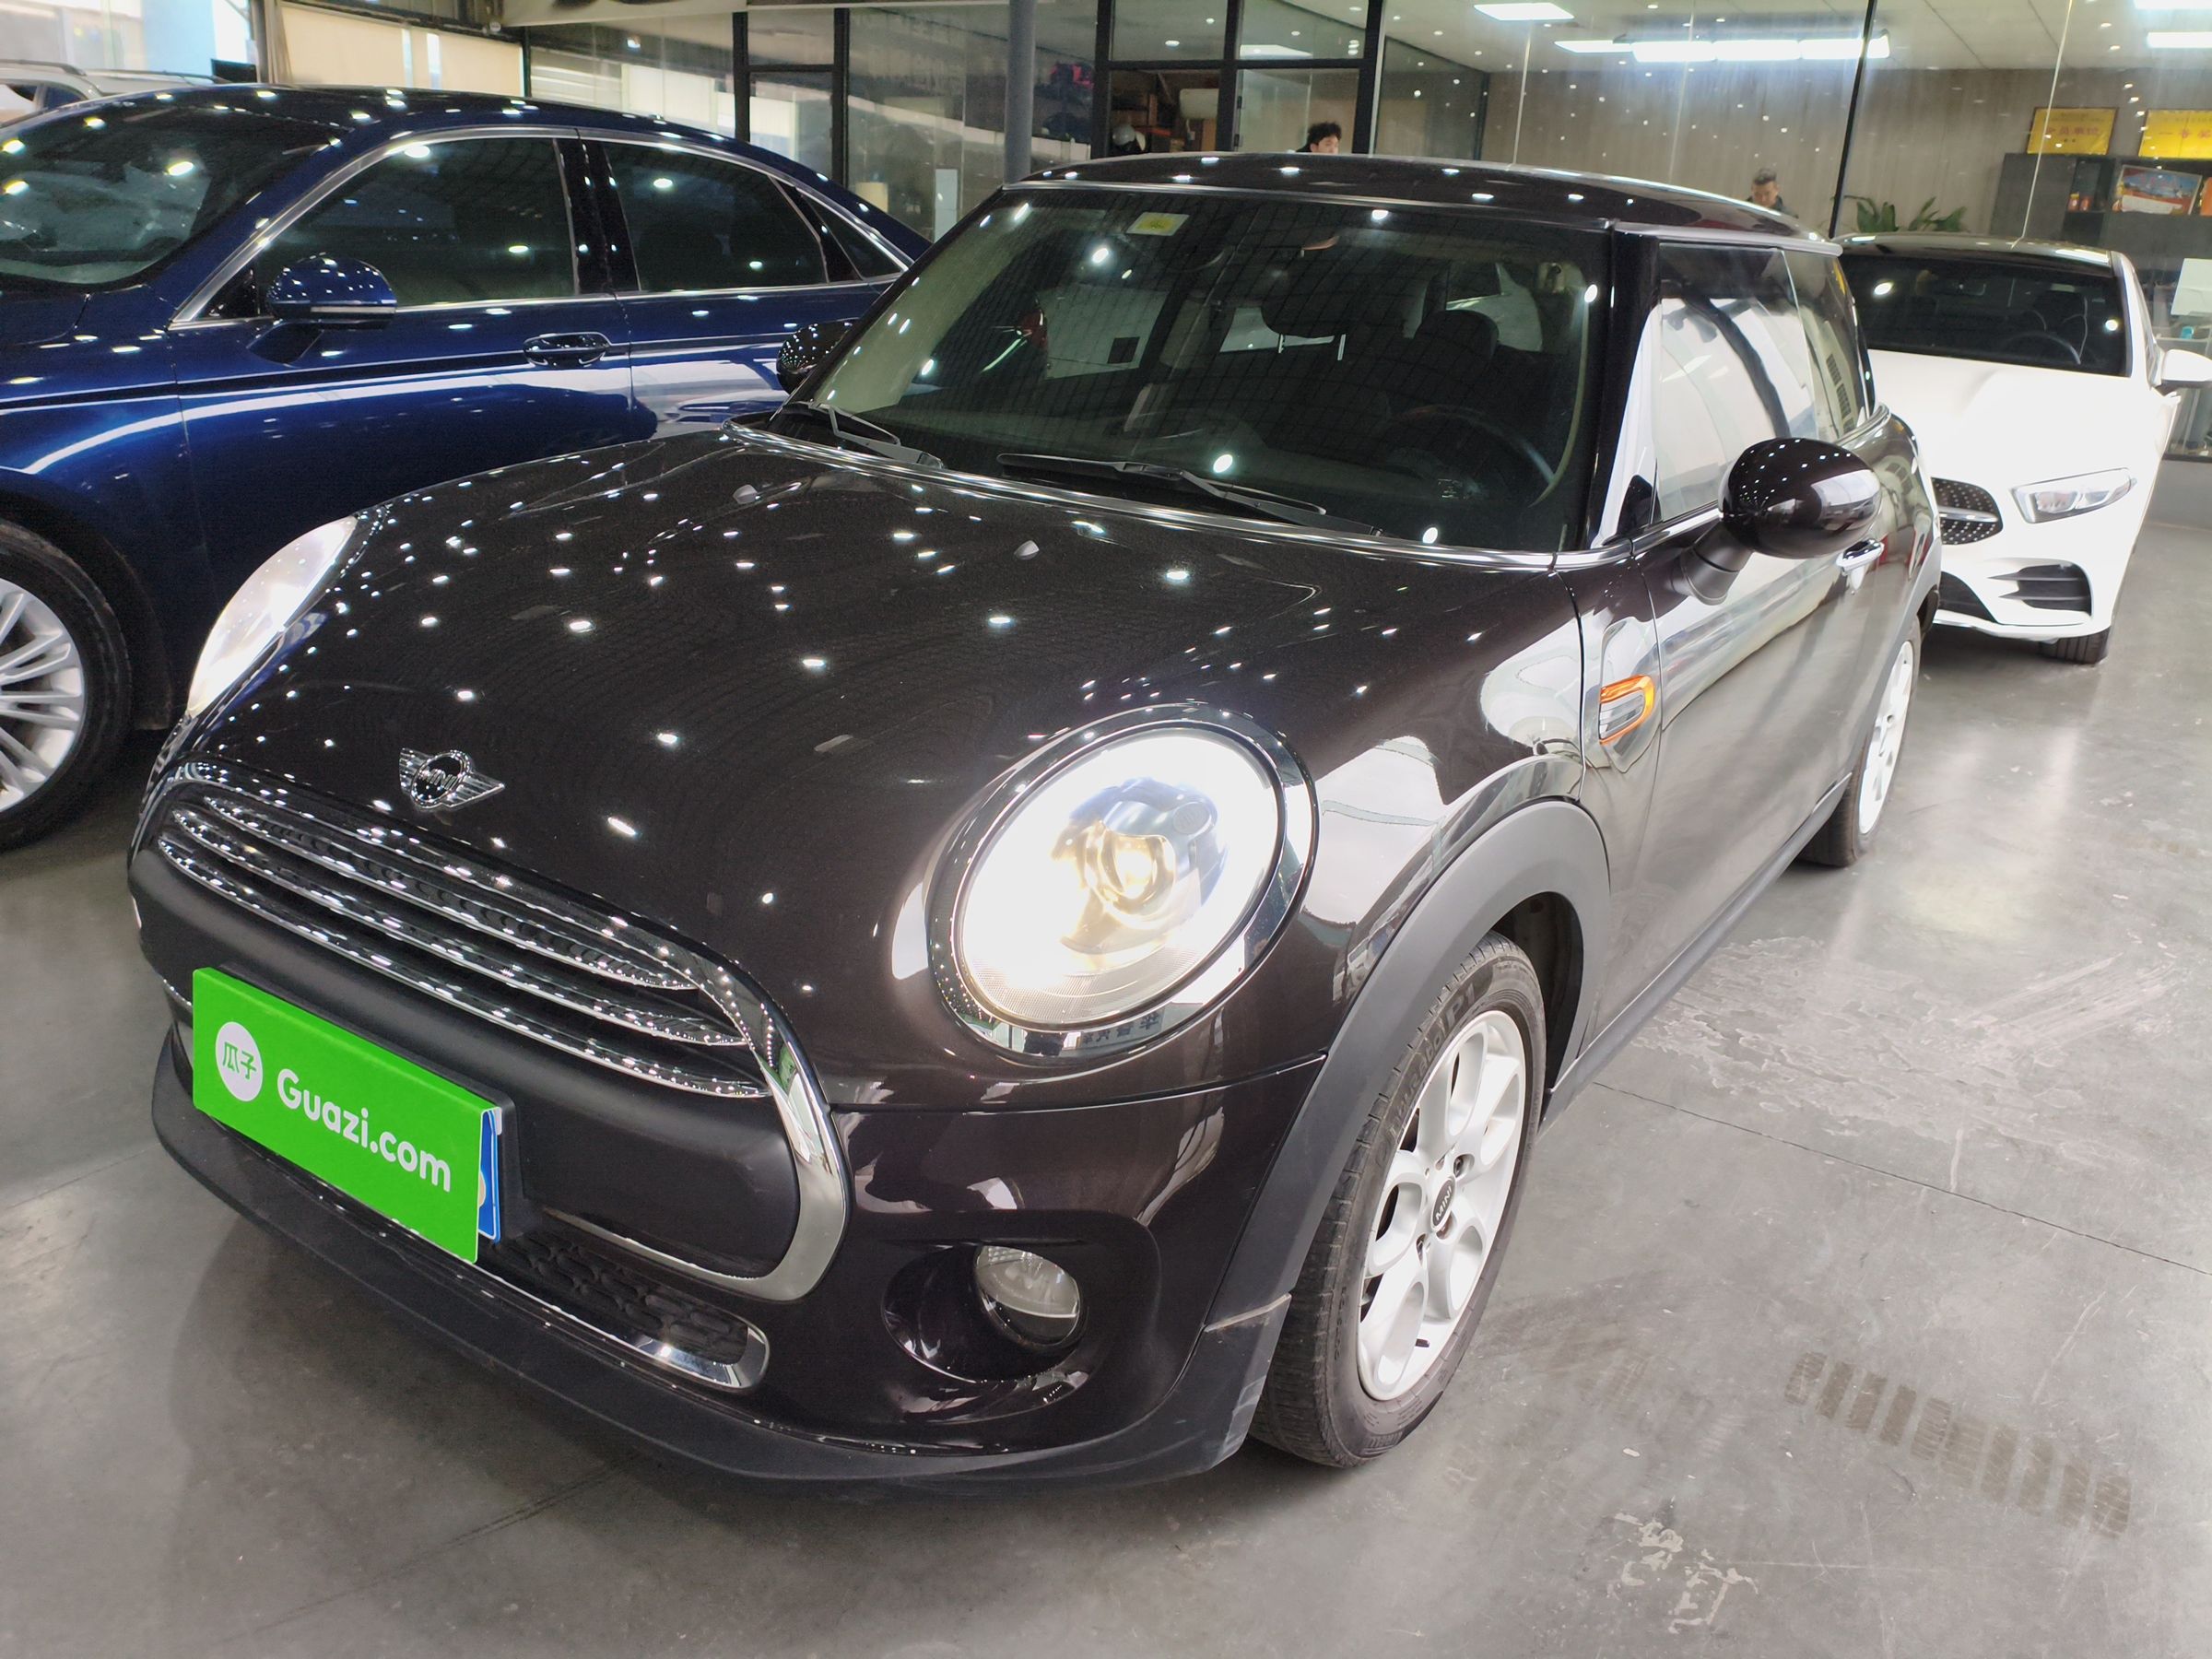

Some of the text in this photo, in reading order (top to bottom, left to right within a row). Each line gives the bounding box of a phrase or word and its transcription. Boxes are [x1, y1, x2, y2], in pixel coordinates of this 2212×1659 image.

[221, 1041, 257, 1080] 瓜子
[277, 1068, 451, 1193] Guazi.com
[1435, 1185, 1452, 1220] MINI
